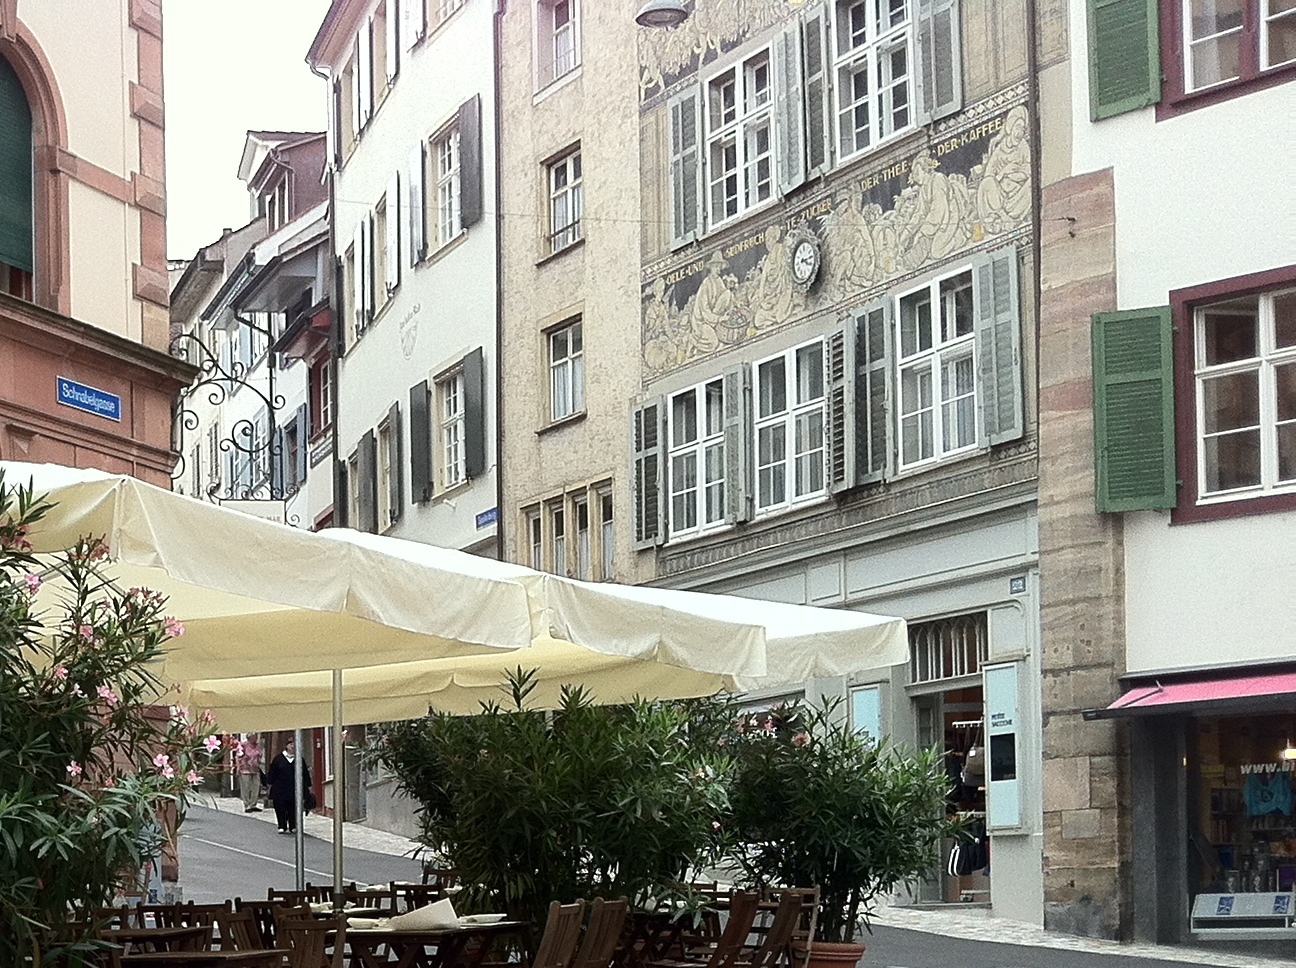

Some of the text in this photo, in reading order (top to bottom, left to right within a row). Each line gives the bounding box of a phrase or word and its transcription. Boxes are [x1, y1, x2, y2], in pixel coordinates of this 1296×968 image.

[861, 176, 880, 192] DER
[882, 160, 910, 181] THEE
[937, 137, 959, 157] DER
[961, 117, 1003, 146] KAFFEE
[62, 383, 116, 413] Schnabelgasse
